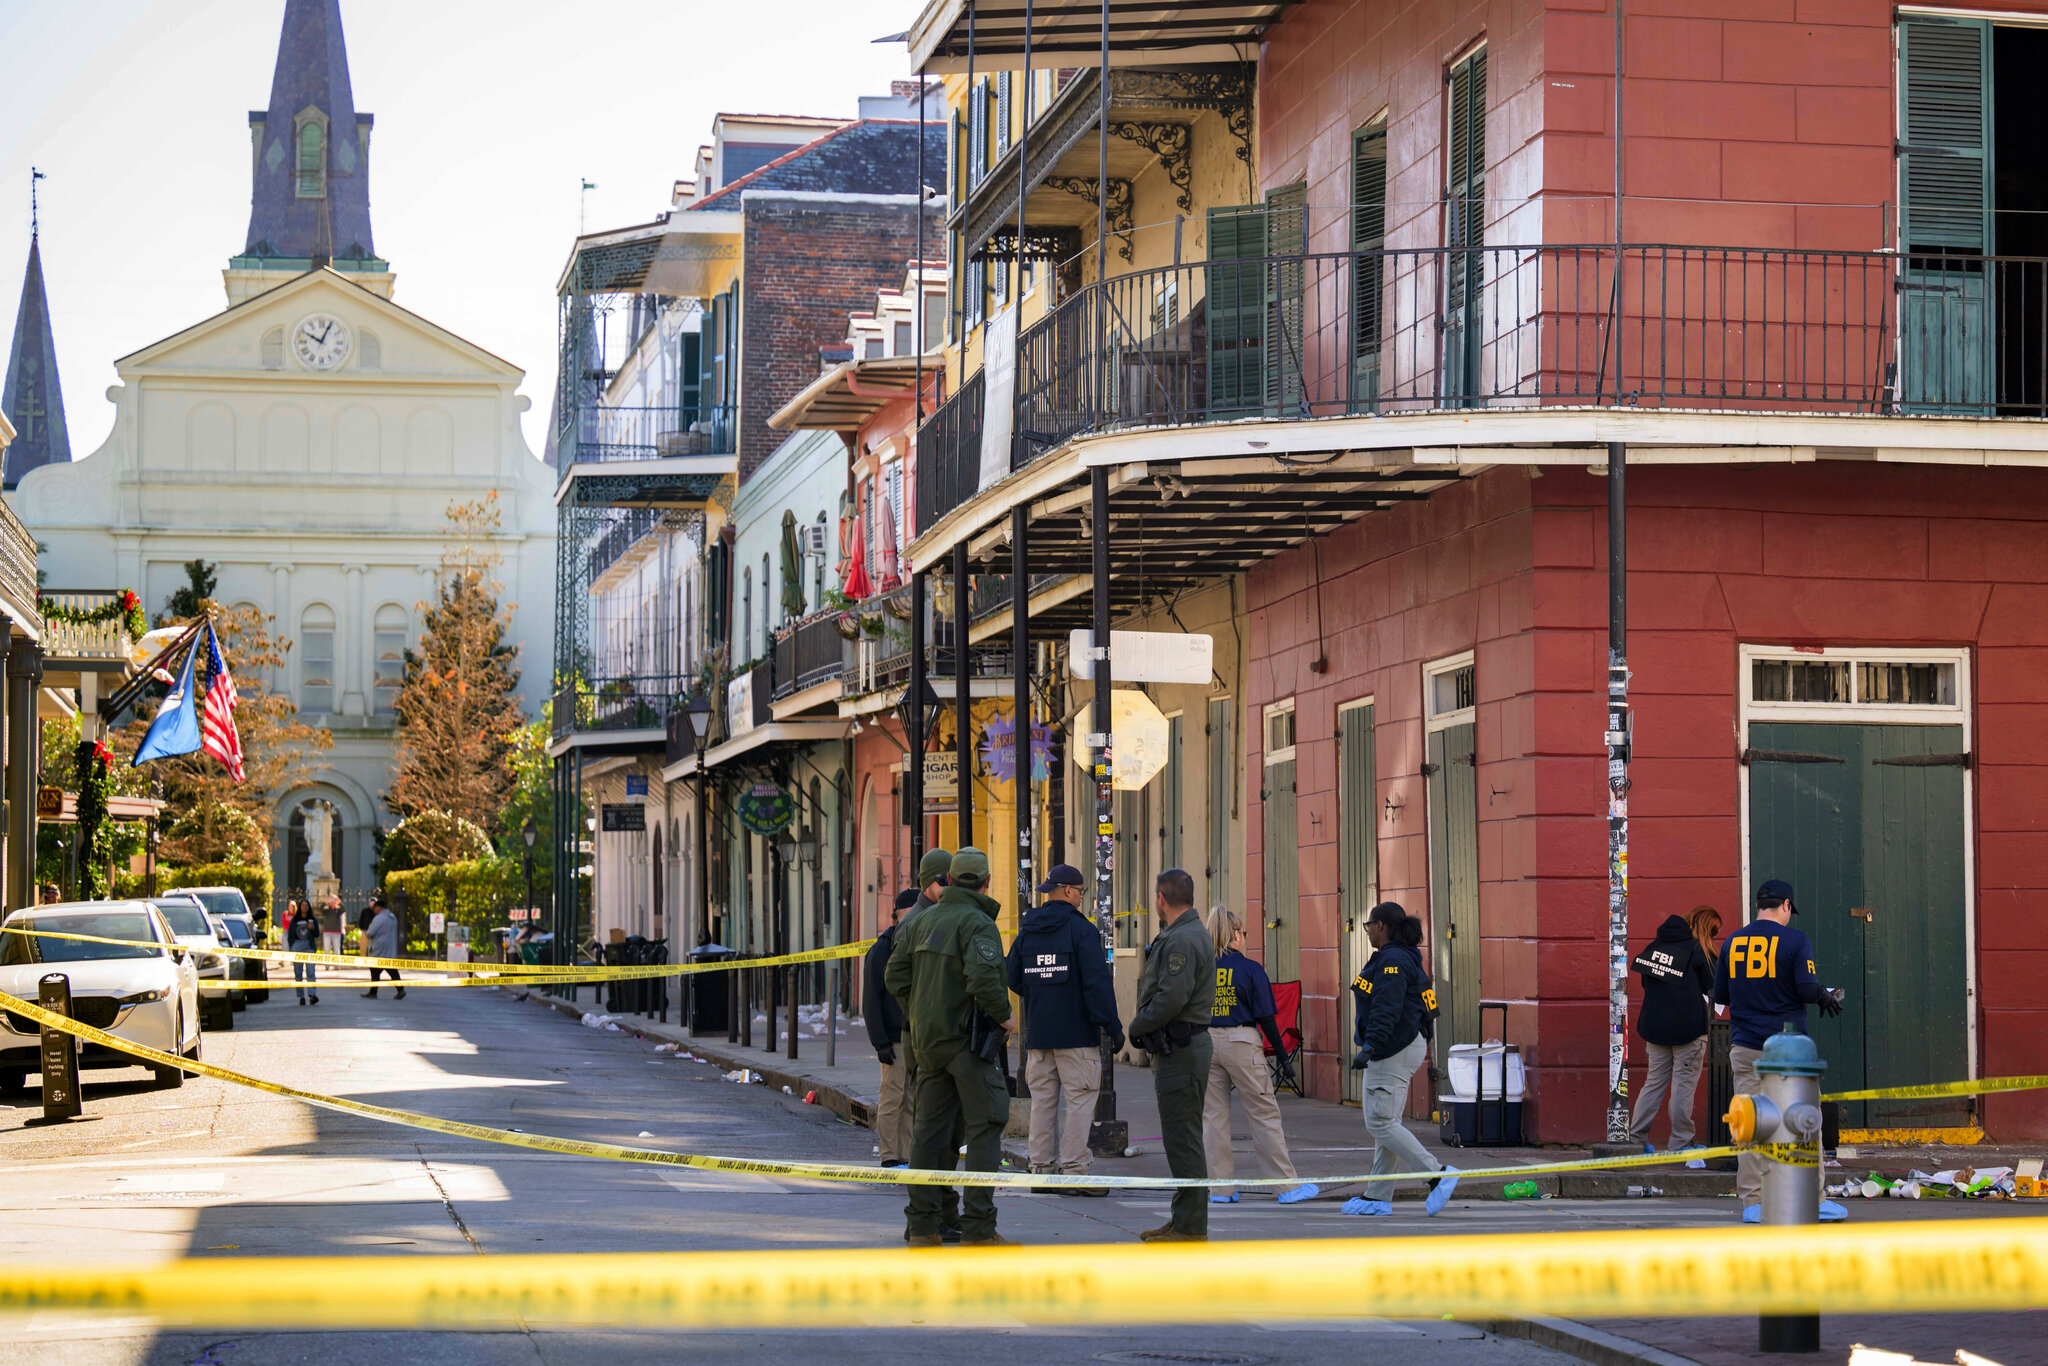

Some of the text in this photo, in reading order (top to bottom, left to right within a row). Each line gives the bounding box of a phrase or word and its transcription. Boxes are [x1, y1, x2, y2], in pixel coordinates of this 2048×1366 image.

[1037, 954, 1056, 966] FBI
[1651, 950, 1674, 966] FBI
[1729, 936, 1779, 979] FBI
[1024, 966, 1046, 974] EVIDENCE
[1384, 966, 1399, 975] FBI
[1635, 957, 1684, 978] EVIDENCE RESPONSE
[1651, 968, 1666, 977] TEAM
[1216, 968, 1233, 986] BI
[1214, 987, 1235, 997] DENCE
[1354, 976, 1374, 995] FBI
[1214, 996, 1237, 1006] PONSE
[1421, 988, 1439, 1012] FB
